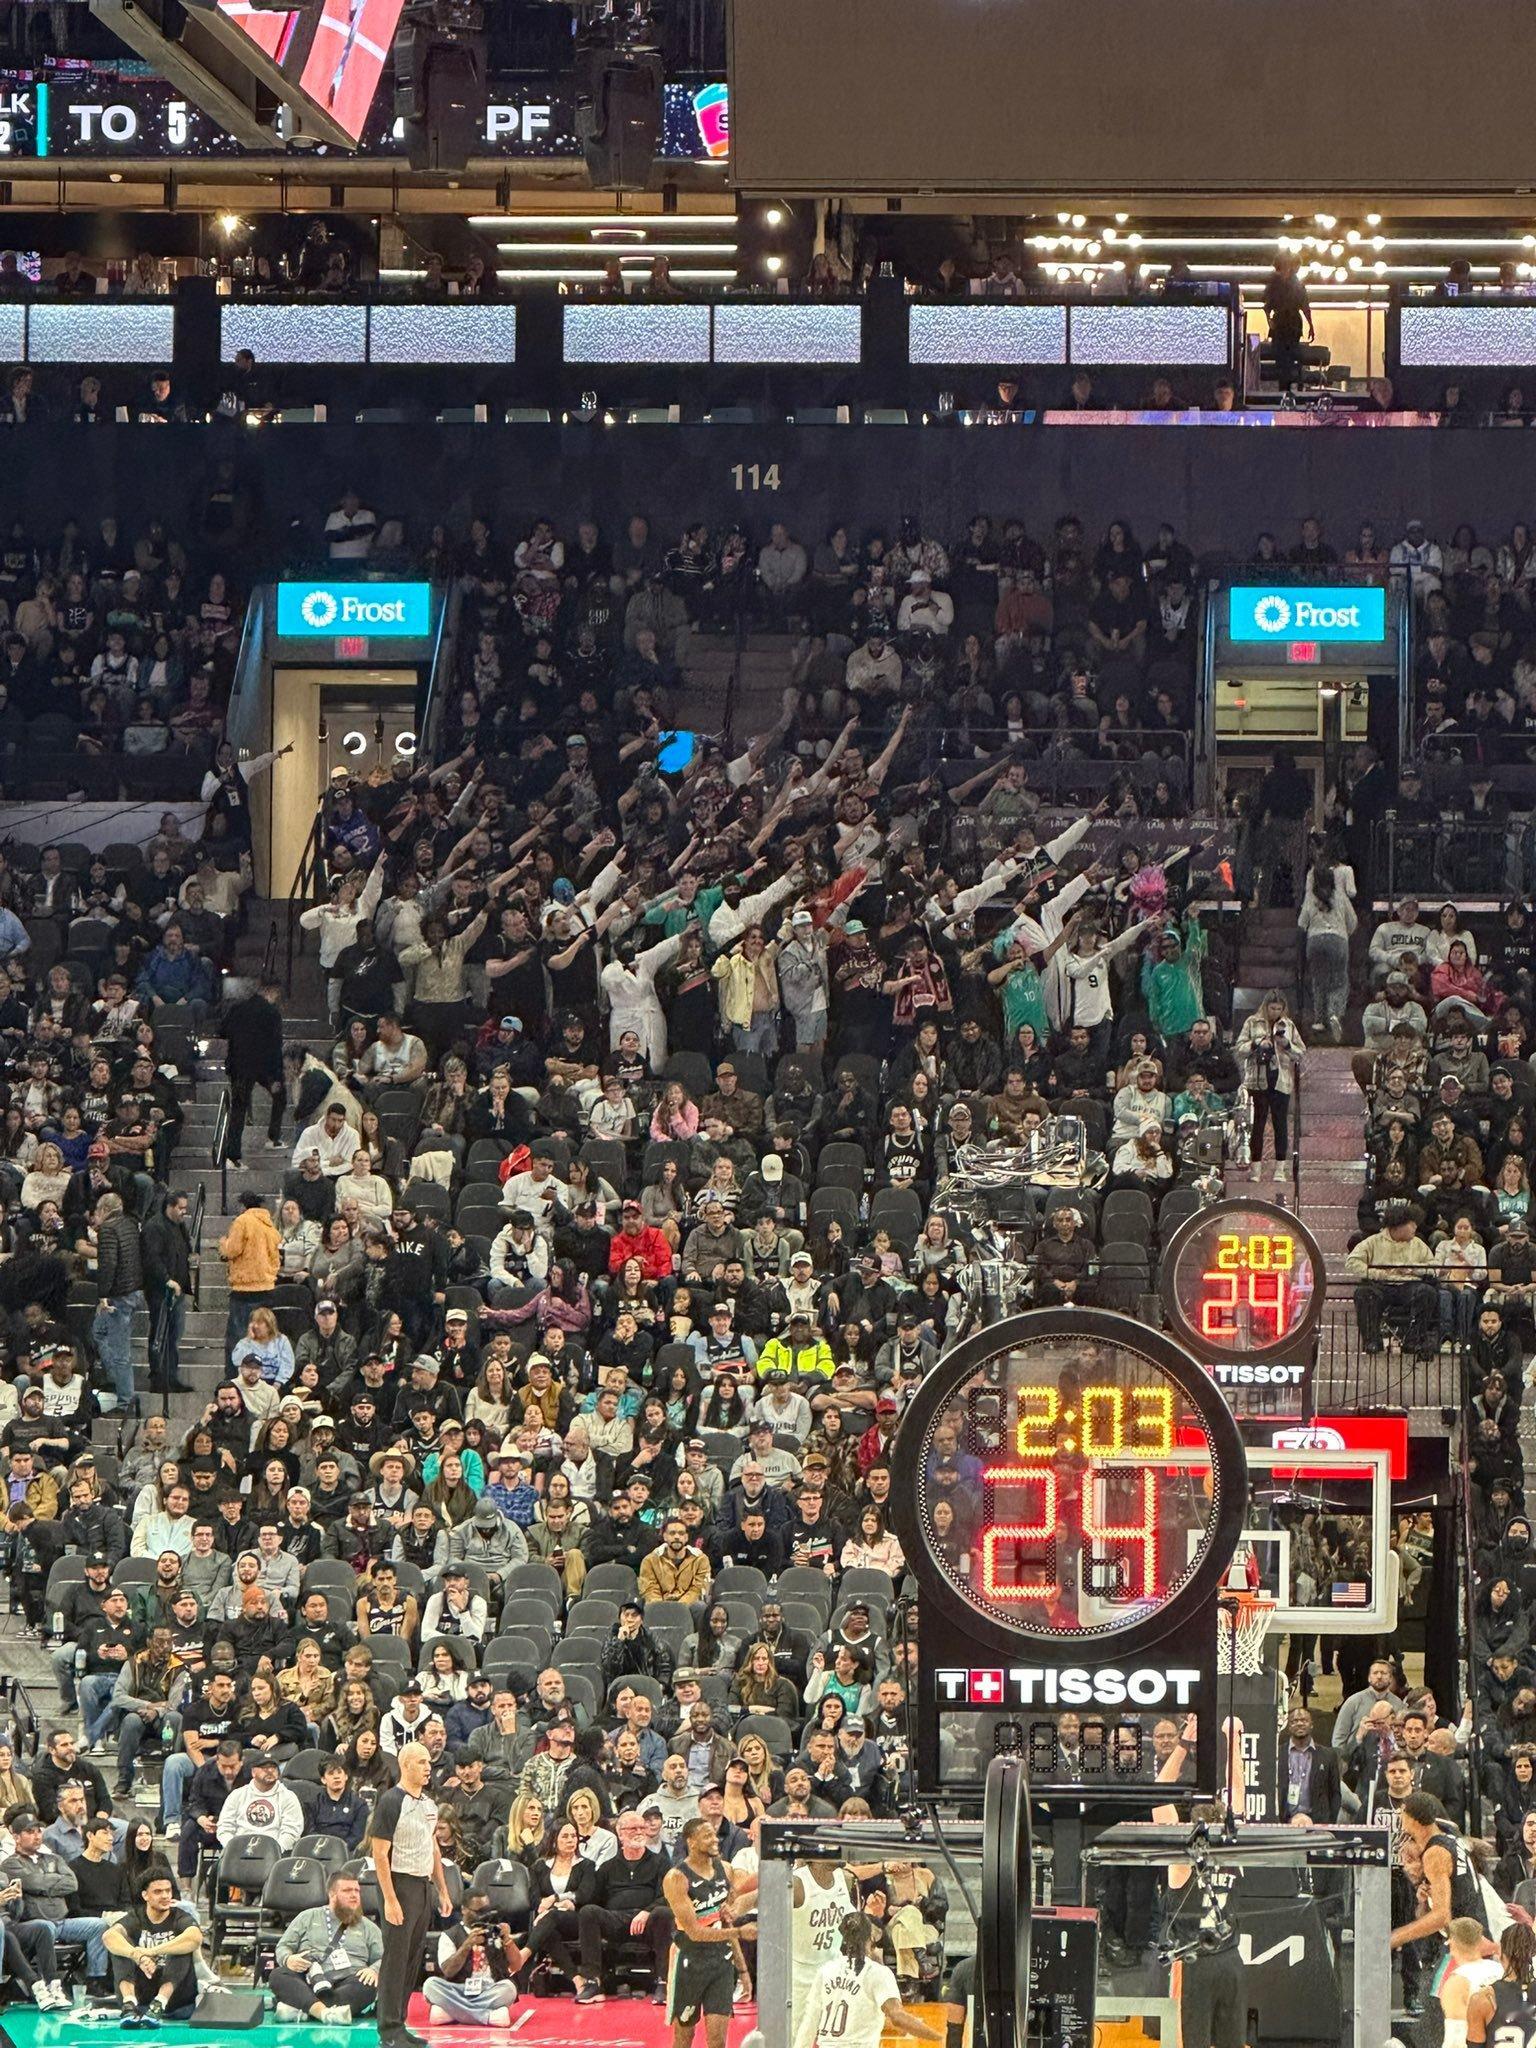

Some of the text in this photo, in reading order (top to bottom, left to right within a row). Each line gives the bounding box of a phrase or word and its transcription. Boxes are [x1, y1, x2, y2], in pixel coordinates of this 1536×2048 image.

[68, 101, 187, 144] TO 5
[486, 105, 550, 141] PF
[731, 464, 781, 490] 114
[341, 597, 406, 622] Frost
[1295, 602, 1361, 628] Frost
[1088, 974, 1098, 988] 9
[1023, 991, 1036, 1002] 10
[1218, 1234, 1294, 1269] 2:03
[1202, 1272, 1284, 1336] 24
[1216, 1365, 1305, 1383] TISSOT
[1016, 1386, 1174, 1457] 2:03
[982, 1466, 1156, 1598] 24
[1010, 1668, 1200, 1704] TISSOT
[1240, 1733, 1260, 1759] ET
[1245, 1794, 1267, 1821] pp
[810, 1905, 844, 1928] CAVS
[812, 1929, 835, 1950] 45
[816, 2000, 849, 2037] 10
